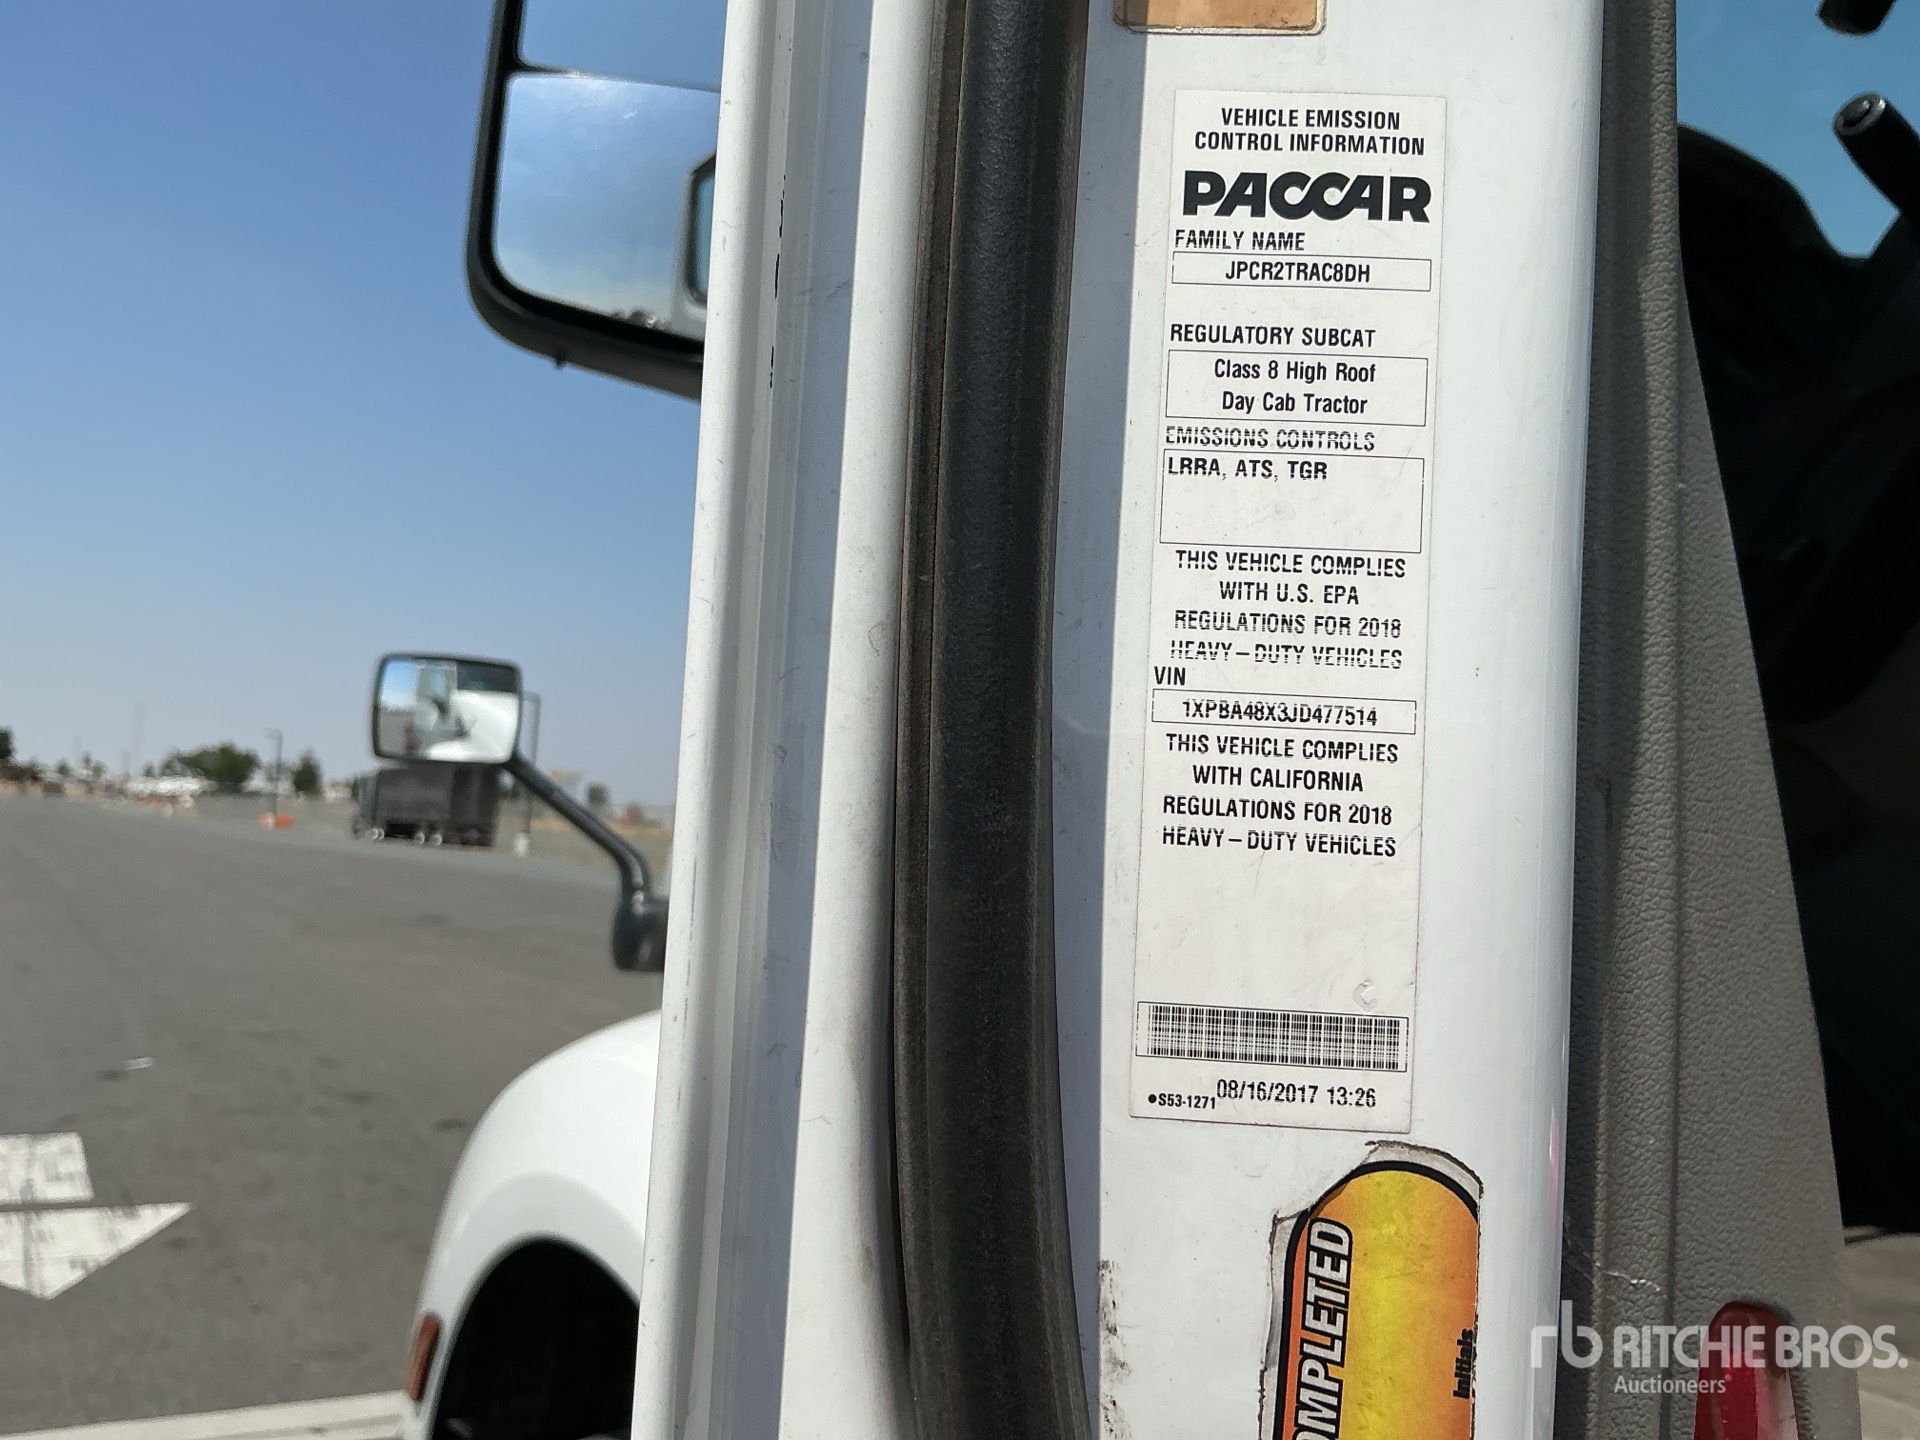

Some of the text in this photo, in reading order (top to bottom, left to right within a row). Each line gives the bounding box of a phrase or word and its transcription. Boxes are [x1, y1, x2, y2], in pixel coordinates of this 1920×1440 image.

[1221, 108, 1400, 130] VEHICLE EMISSION
[1195, 131, 1425, 155] CONTROL INFORMATION
[1183, 170, 1431, 223] PACCAR
[1175, 230, 1305, 251] FAMILY NAME
[1225, 260, 1370, 282] JPCR2TRAC8DH
[1170, 324, 1376, 347] REGULATORY SUBCAT
[1214, 359, 1376, 384] Class 8 High Roof
[1222, 392, 1368, 413] Day Cab Tractor
[1165, 426, 1376, 451] EMISSIONS CONTROLS
[1168, 457, 1328, 482] LRRA, ATS, TGR
[1176, 550, 1406, 577] THIS VEHICLE COMPLIES
[1220, 582, 1359, 605] WITH U.S. EPA
[1174, 610, 1402, 637] REGULATIONS FOR 2018
[1312, 647, 1403, 669] VEHICLES
[1154, 666, 1186, 685] VIN
[1182, 699, 1378, 726] 1XPBA48X3JD477514
[1166, 733, 1398, 763] THIS VEHICLE COMPLIES
[1192, 765, 1363, 792] WITH CALIFORNIA
[1163, 796, 1393, 826] REGULATIONS FOR 2018
[1305, 833, 1396, 857] VEHICLES
[1216, 1079, 1319, 1105] 08/16/2017
[1326, 1086, 1376, 1108] 13:26
